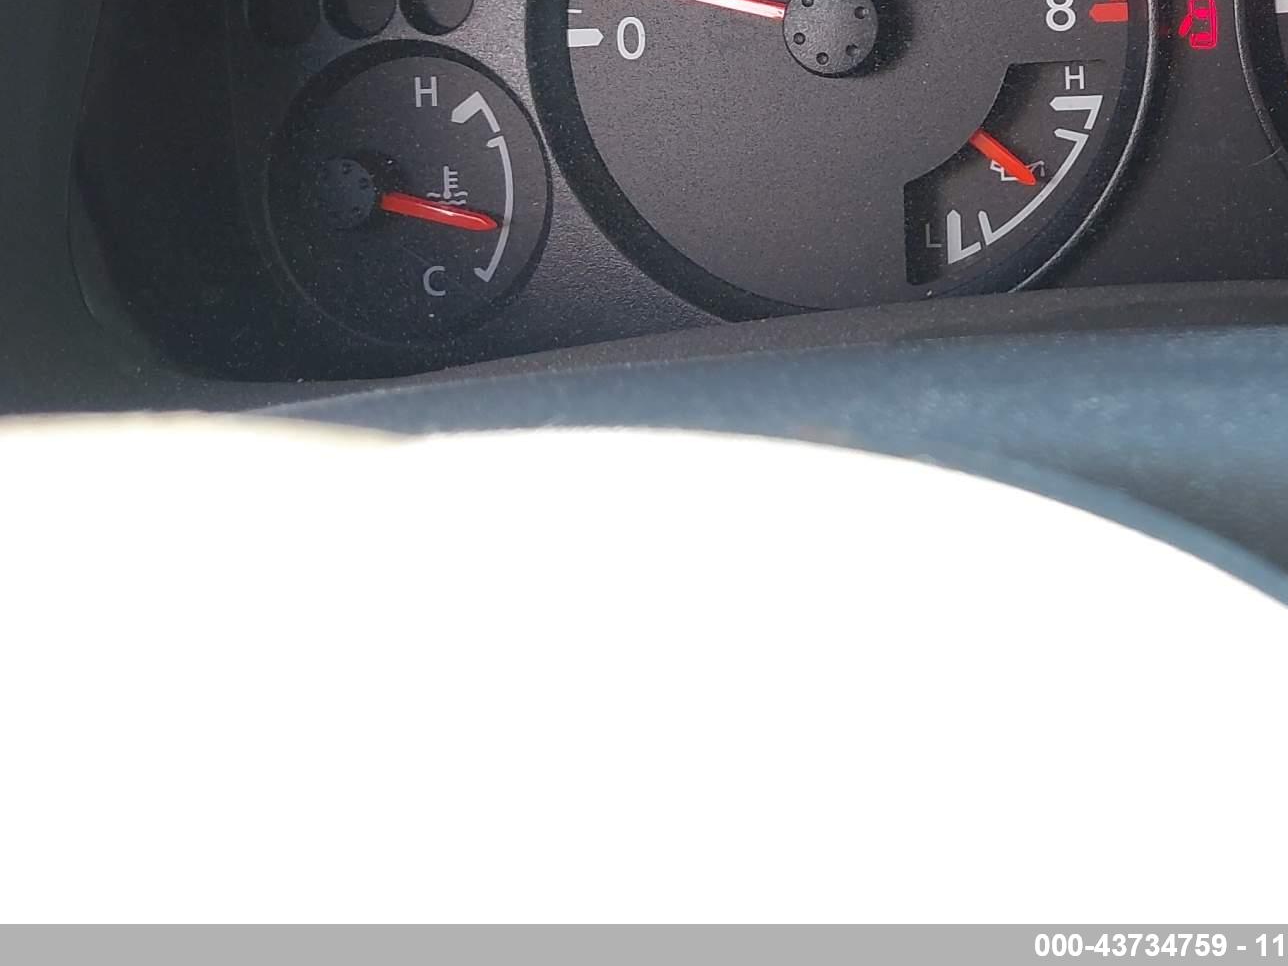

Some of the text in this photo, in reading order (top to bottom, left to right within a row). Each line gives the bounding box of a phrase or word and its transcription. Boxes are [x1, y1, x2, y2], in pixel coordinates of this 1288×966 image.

[616, 16, 646, 60] 0
[414, 76, 438, 108] H
[1064, 65, 1085, 90] H
[423, 265, 446, 297] C
